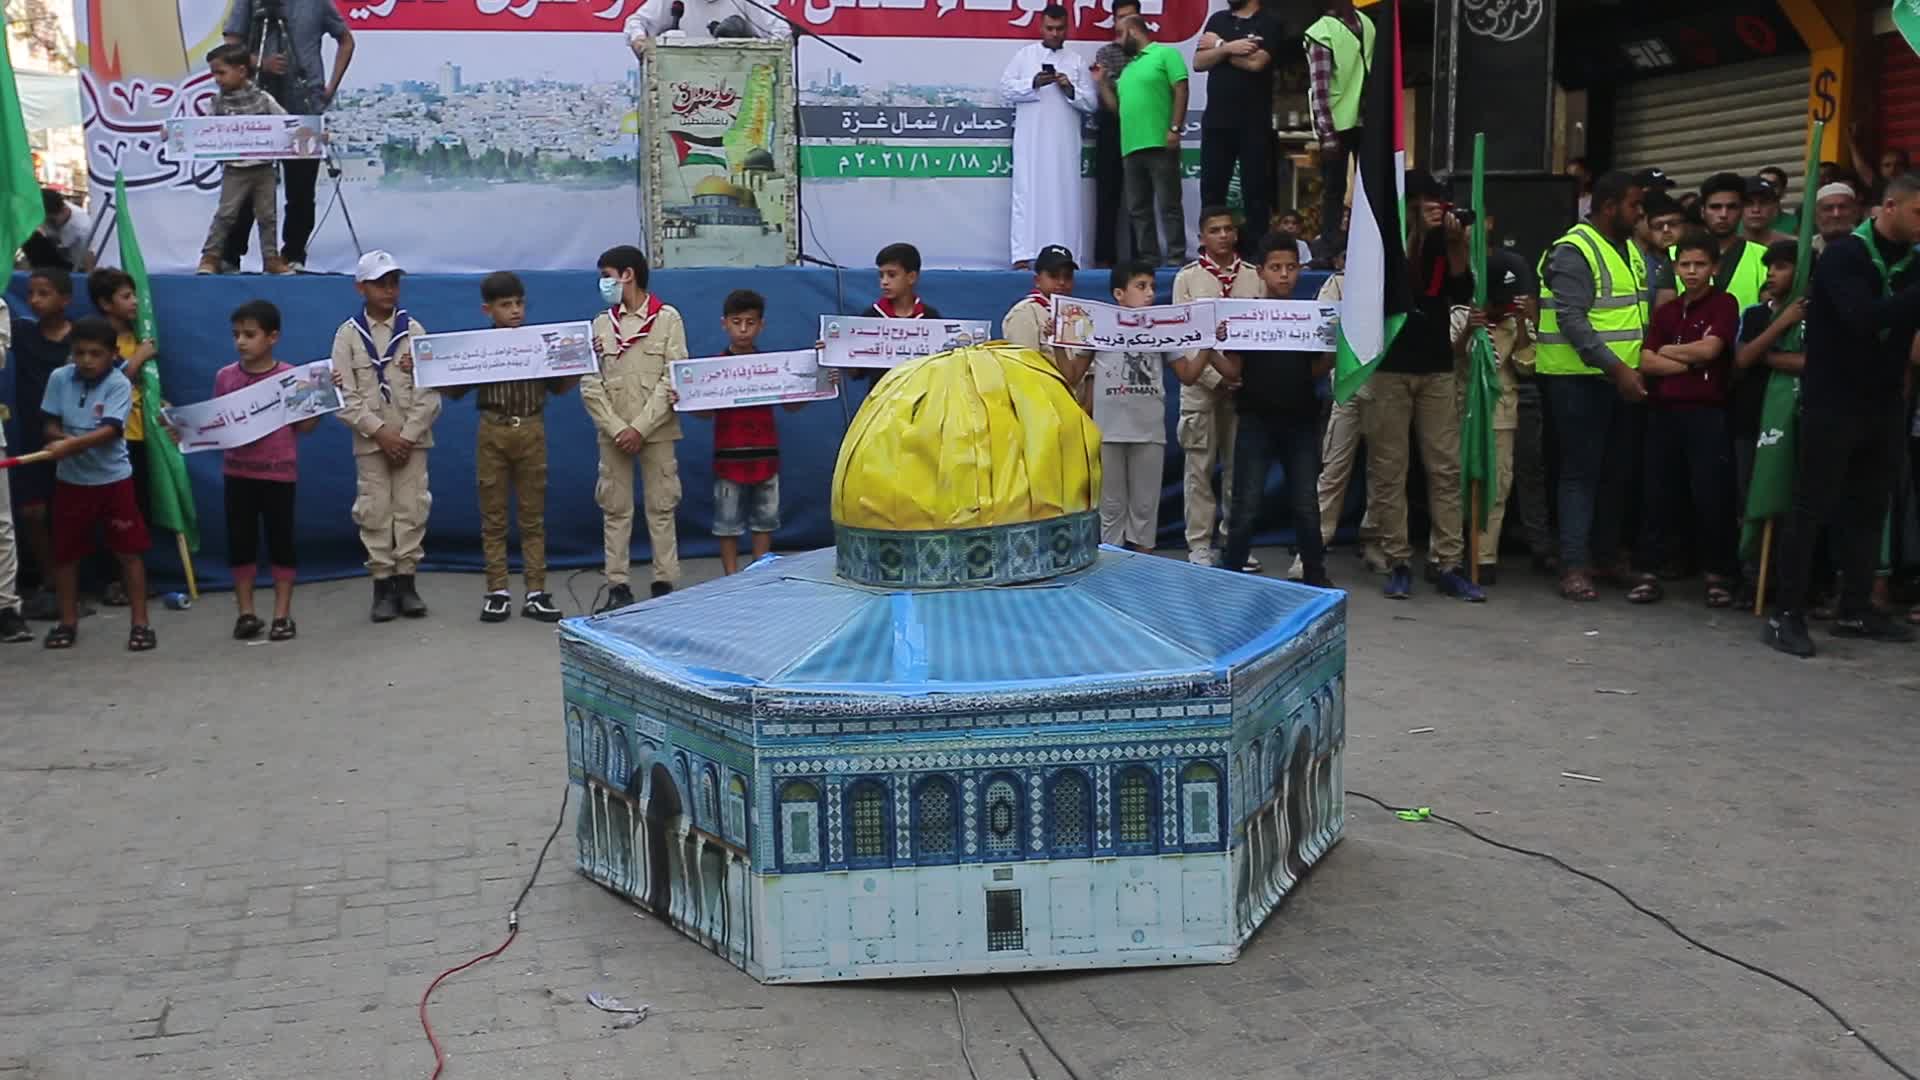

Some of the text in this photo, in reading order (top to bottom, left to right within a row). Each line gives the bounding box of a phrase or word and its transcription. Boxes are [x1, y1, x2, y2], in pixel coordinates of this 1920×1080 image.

[841, 110, 889, 133] غزة
[890, 110, 938, 134] شمال
[952, 112, 1008, 135] حماس
[1093, 329, 1202, 348] فجر حريتكم قريب
